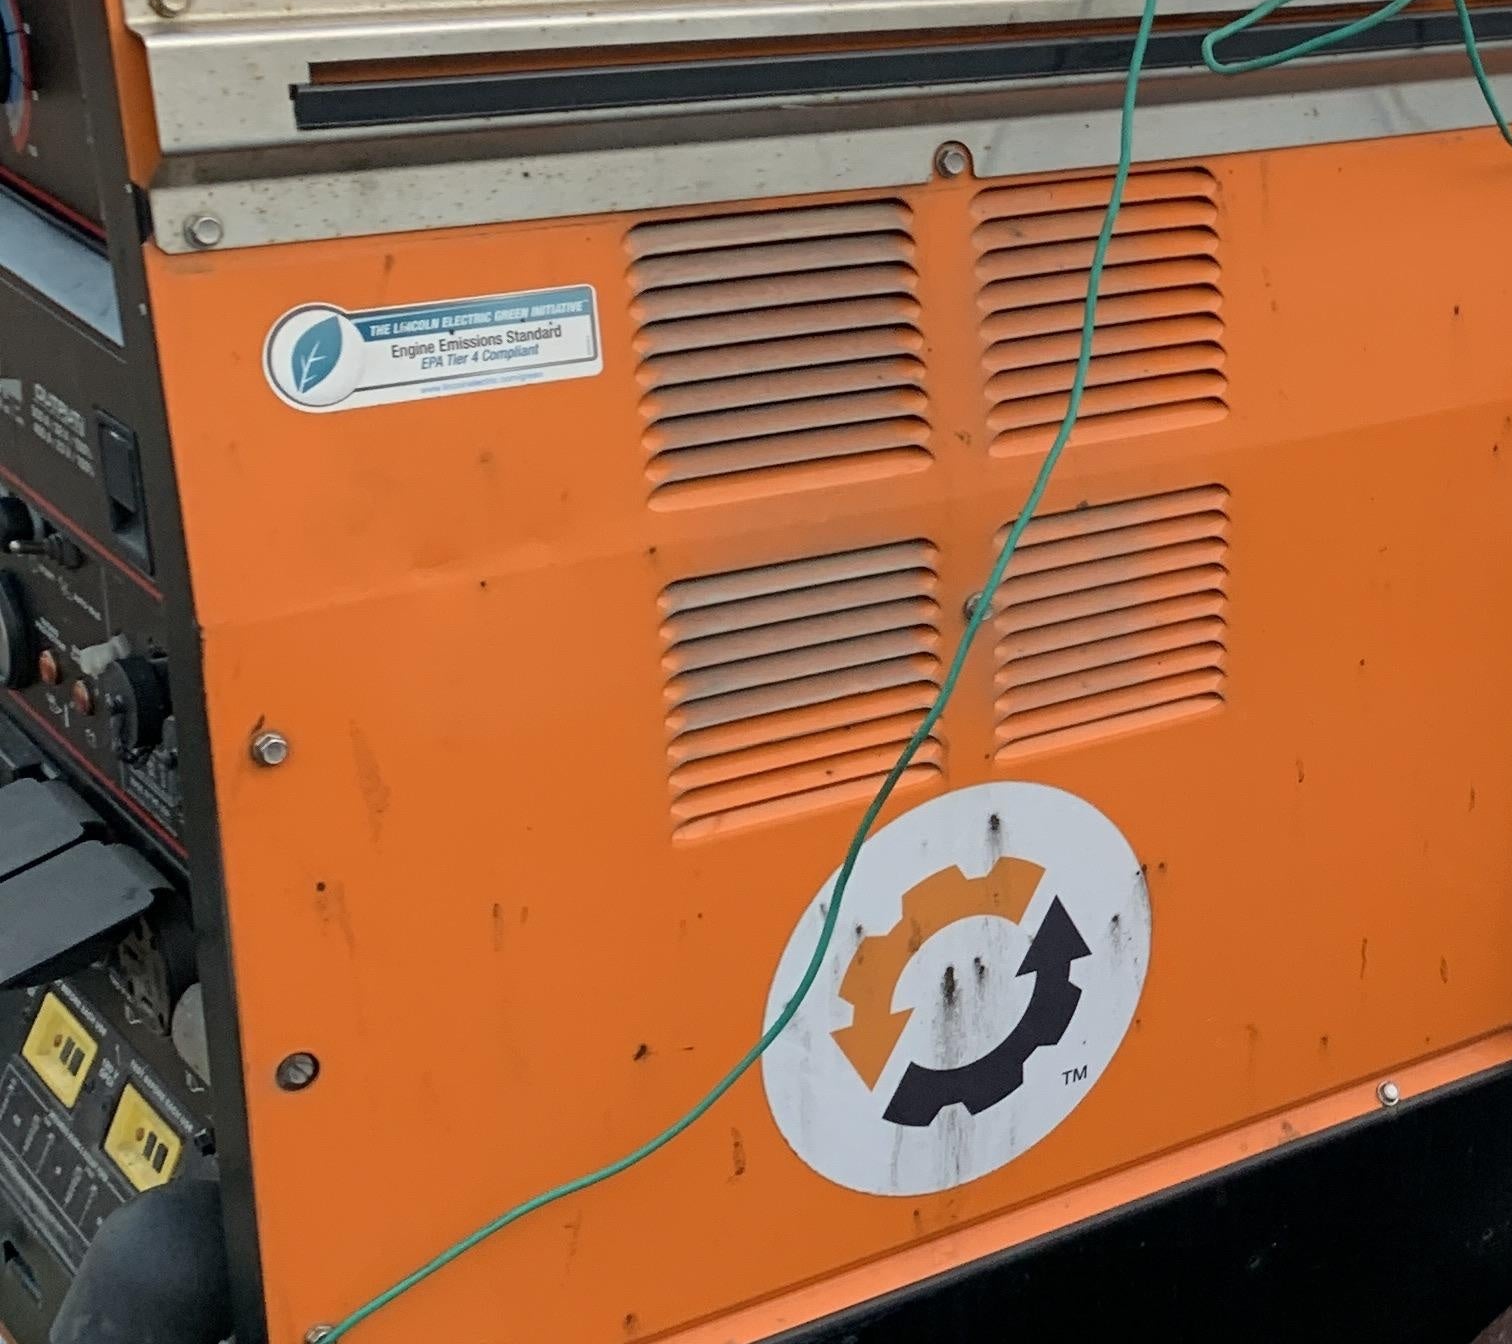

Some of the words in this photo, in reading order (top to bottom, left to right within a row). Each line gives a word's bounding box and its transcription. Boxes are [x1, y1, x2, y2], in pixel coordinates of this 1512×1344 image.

[370, 324, 391, 337] THE
[441, 311, 492, 329] ELECTRIC
[494, 305, 528, 323] GREEN
[391, 339, 435, 359] Engine
[439, 332, 503, 352] Emissions
[506, 324, 562, 344] Standard
[420, 355, 444, 370] EPA
[447, 351, 468, 366] Tier
[471, 350, 480, 363] 4
[482, 343, 540, 363] Compliant
[1062, 1064, 1089, 1087] TM
